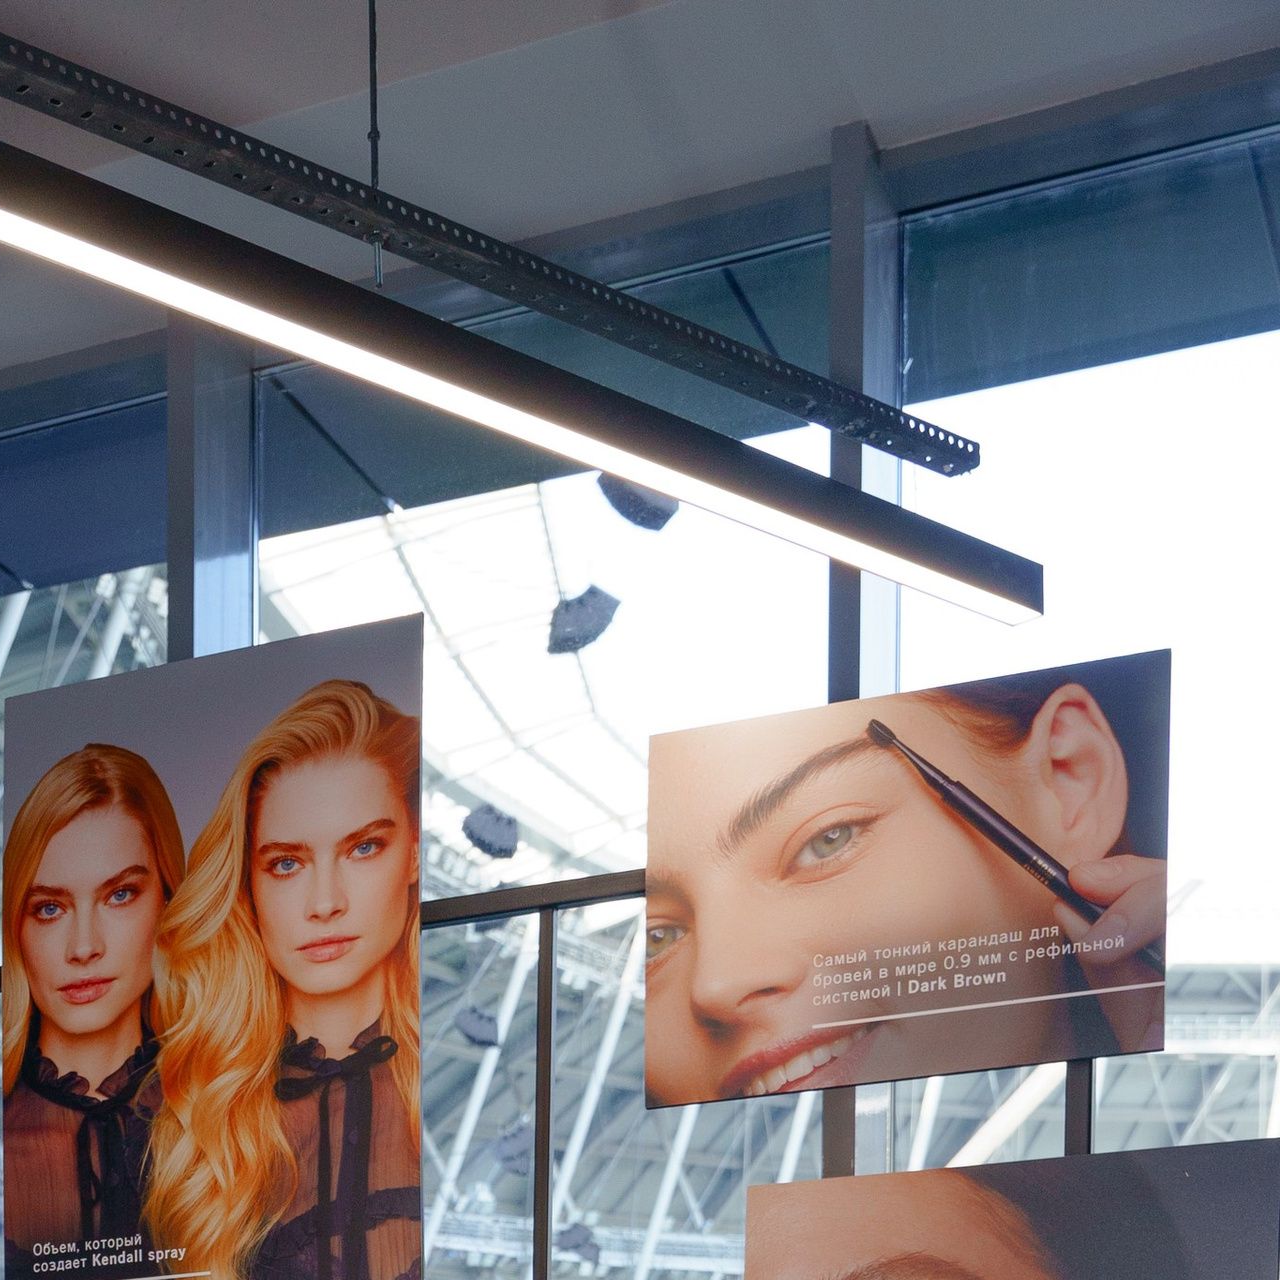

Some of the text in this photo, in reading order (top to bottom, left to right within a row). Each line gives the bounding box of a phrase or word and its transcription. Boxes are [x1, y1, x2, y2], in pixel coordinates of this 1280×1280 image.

[812, 925, 1060, 968] Самый тонкий карандаш для
[812, 935, 1125, 988] бровей в мире 0.9 мм с рефильной
[812, 984, 891, 1006] системой
[907, 977, 947, 995] Dark
[953, 970, 1006, 988] Brown
[32, 1234, 142, 1257] Объем, который
[32, 1247, 186, 1273] создает Kendall spray
